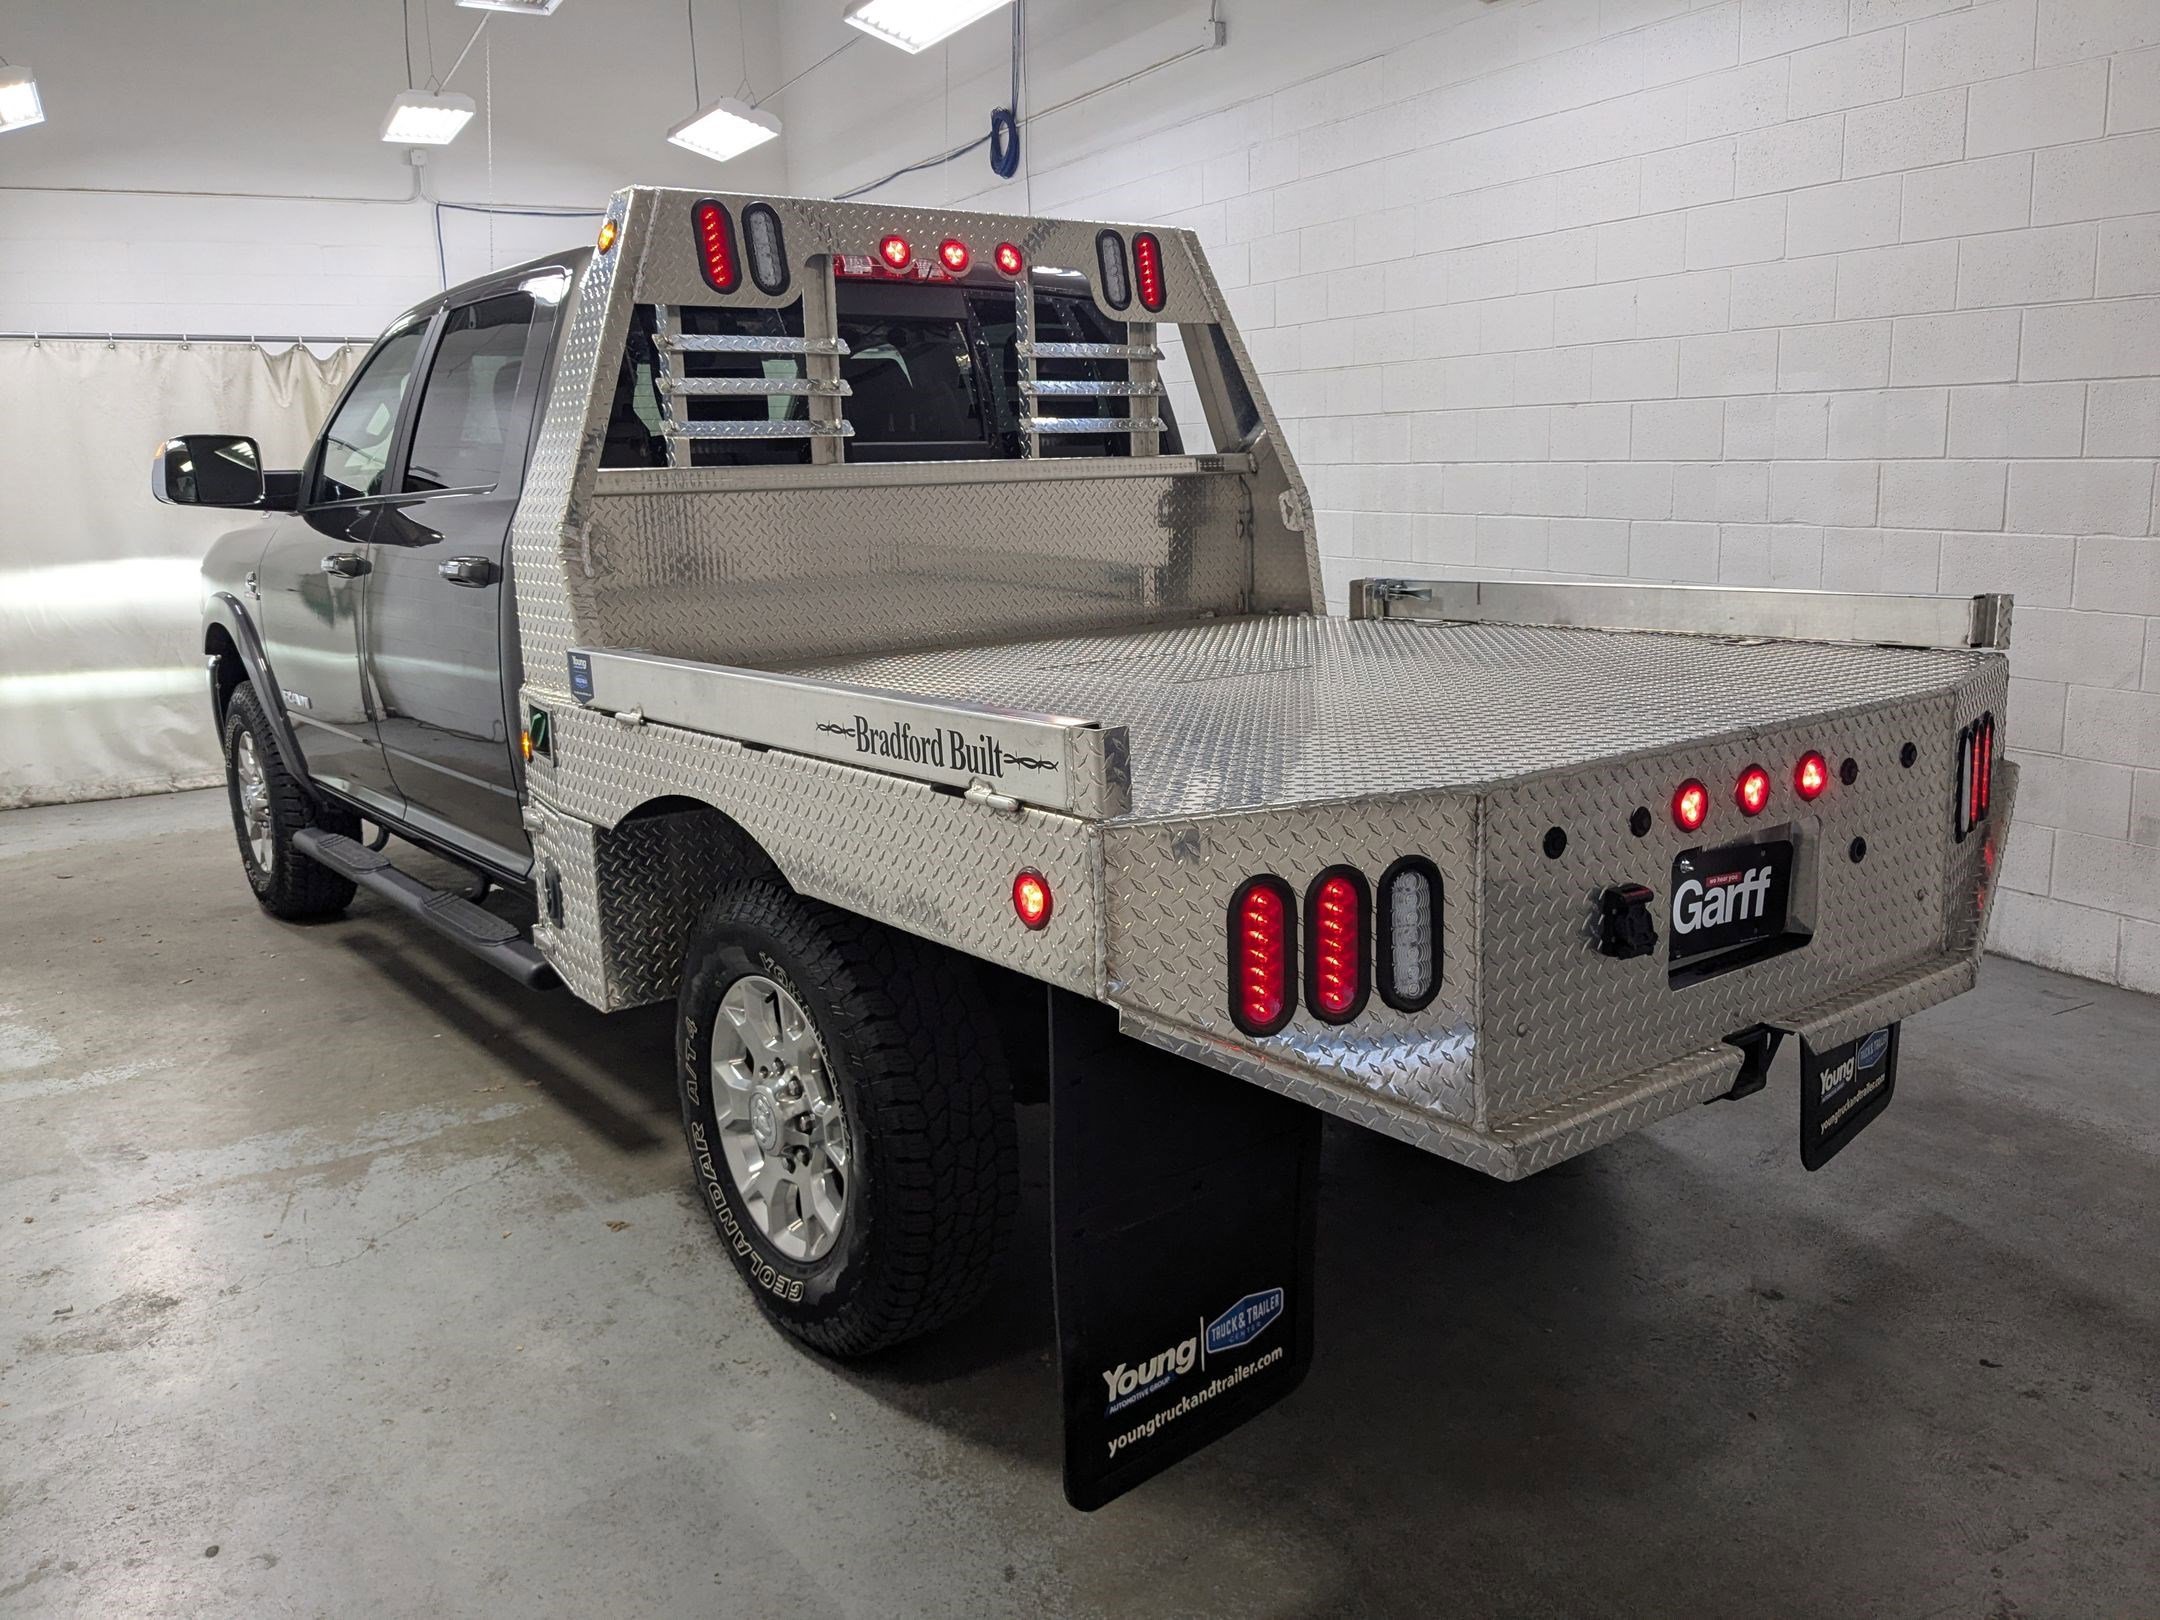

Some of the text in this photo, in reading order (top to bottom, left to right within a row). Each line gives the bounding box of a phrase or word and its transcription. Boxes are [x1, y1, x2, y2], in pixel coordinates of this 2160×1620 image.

[854, 715, 1005, 779] Bradford Built
[1672, 865, 1772, 935] Garff
[1820, 1056, 1855, 1096] Young
[692, 1121, 805, 1303] GEOLANDAR
[1211, 1319, 1238, 1342] TRUCK
[1246, 1293, 1280, 1324] TRAILER
[1102, 1336, 1197, 1402] Young
[1108, 1375, 1171, 1414] AUTOMOTIVE GROUP
[1107, 1346, 1283, 1459] youngtruckandtrailer.com
